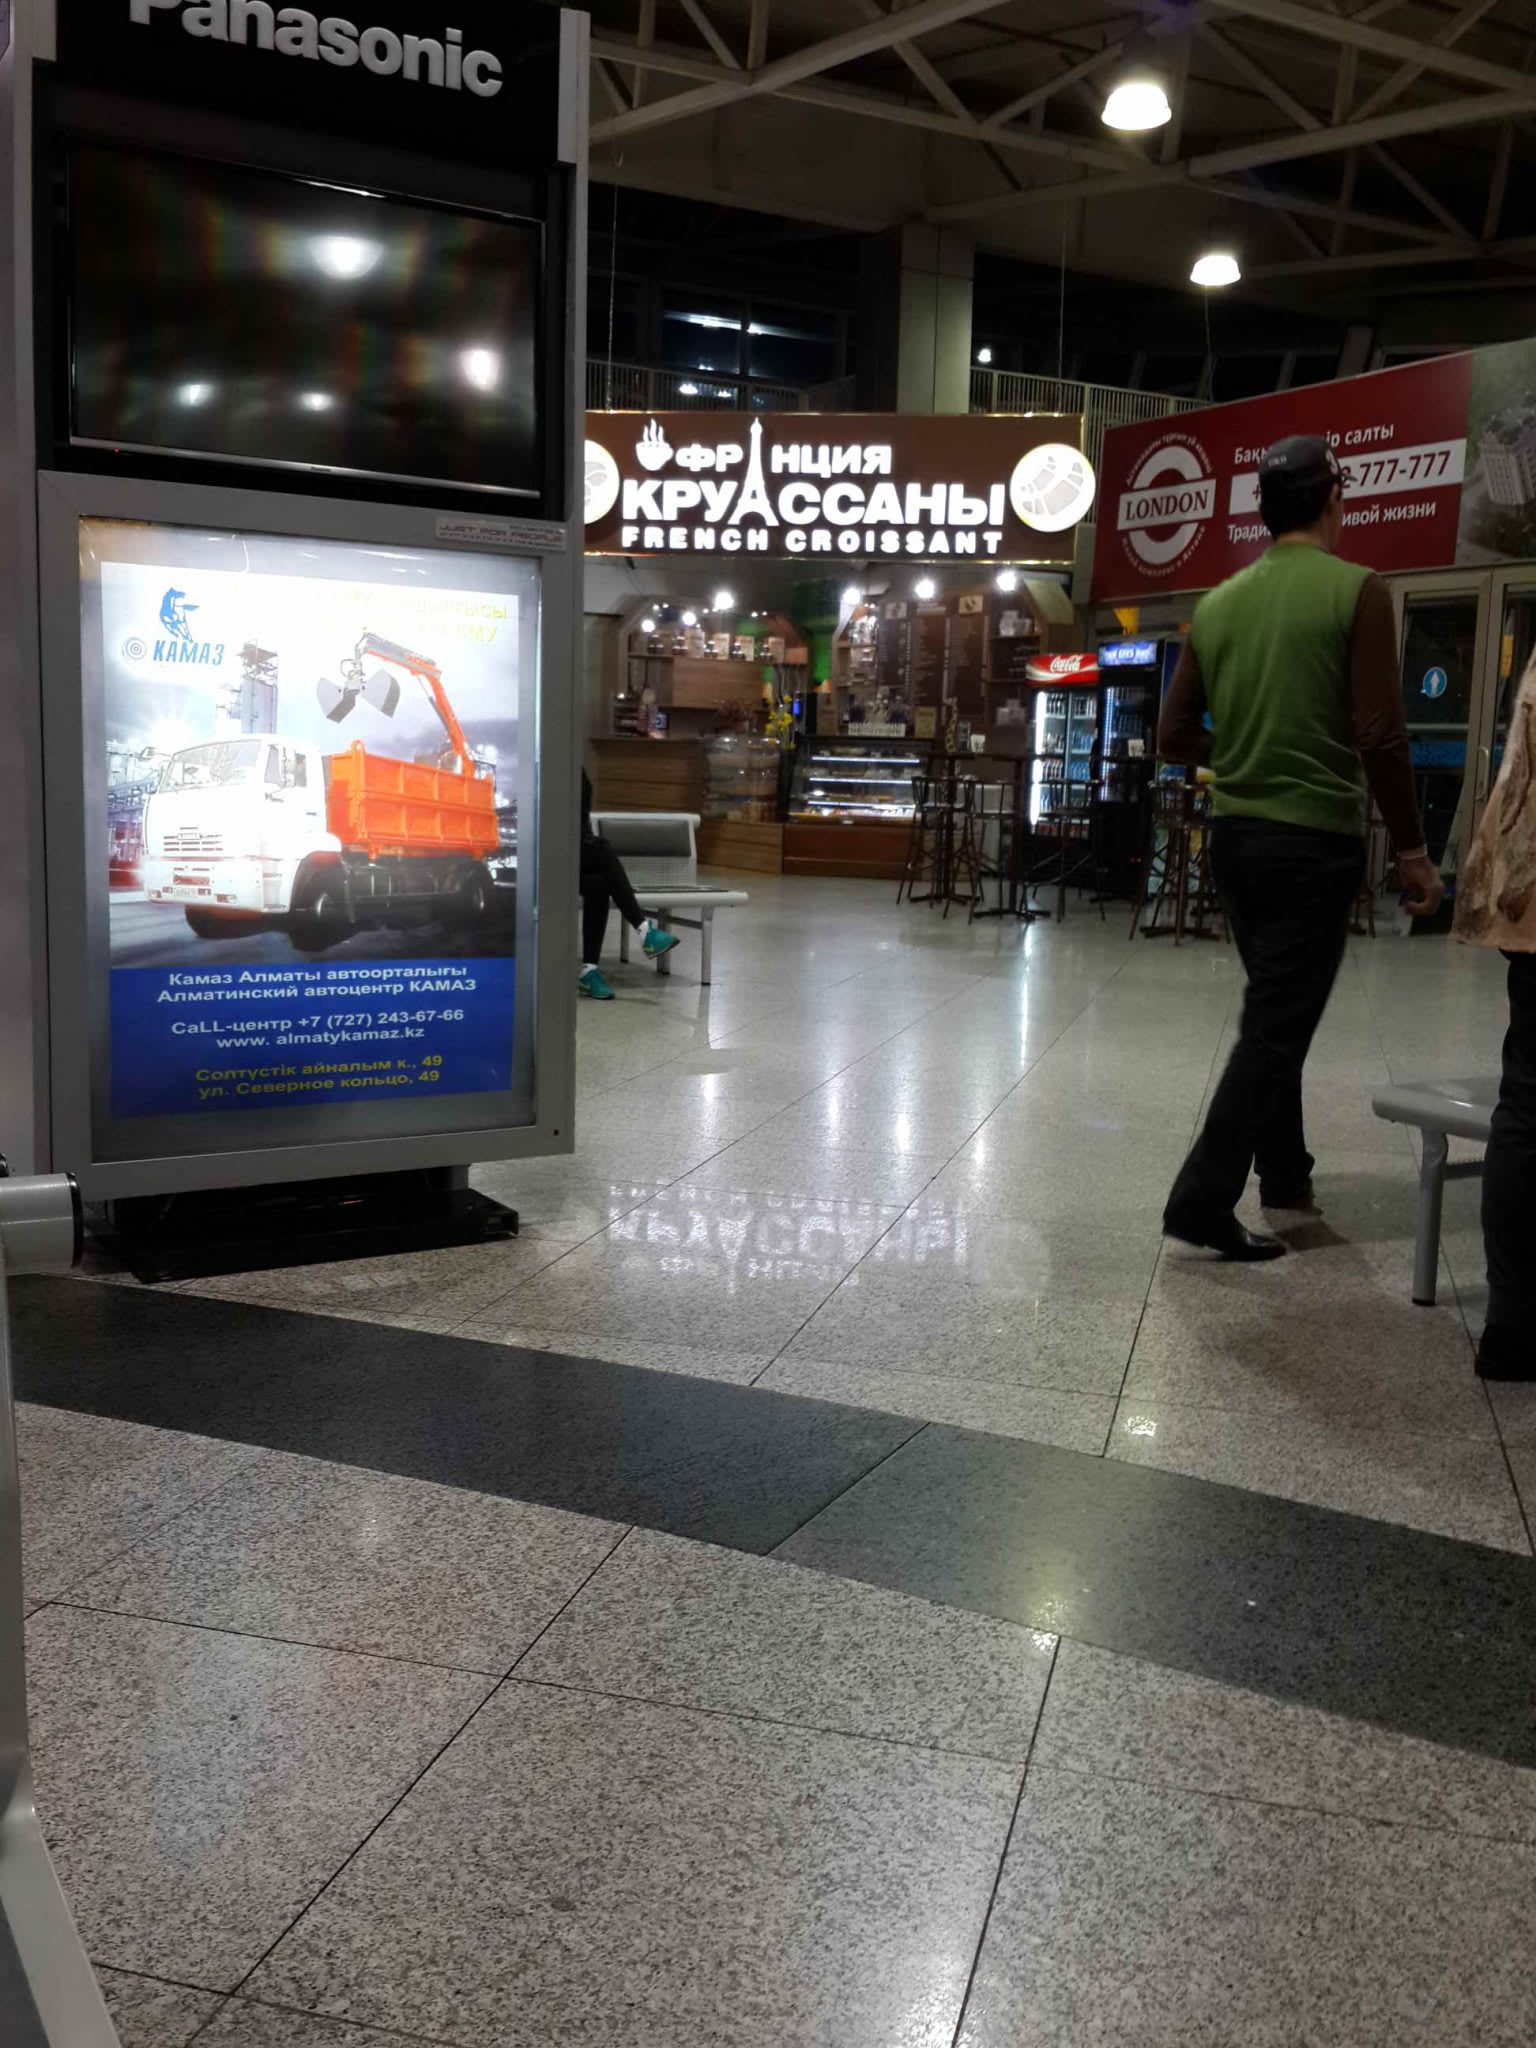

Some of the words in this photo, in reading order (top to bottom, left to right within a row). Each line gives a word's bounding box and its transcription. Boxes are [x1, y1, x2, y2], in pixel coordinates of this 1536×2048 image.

[1344, 424, 1395, 446] салты
[621, 478, 1006, 528] КРУАССАНЫ
[1125, 489, 1210, 521] LONDON
[1383, 502, 1437, 522] жизни
[621, 526, 769, 551] FRENCH
[784, 529, 1003, 555] CROISSANT
[153, 639, 225, 666] КАМАЗ
[169, 972, 233, 986] Камаз
[238, 970, 321, 984] Алматы
[157, 985, 299, 1003] Алматинский
[304, 983, 404, 997] автоцентр
[409, 979, 477, 993] КАМАЗ
[171, 1019, 293, 1035] CaLL-центр
[298, 1015, 321, 1028] +7
[327, 1014, 373, 1030] (727)
[377, 1009, 465, 1025] 243-67-66
[216, 1036, 271, 1049] www.
[276, 1026, 425, 1046] almatykamaz.kz
[302, 1060, 392, 1076] айналым
[422, 1055, 443, 1067] 49
[198, 1085, 231, 1100] ул.
[236, 1079, 335, 1096] Северное
[418, 1070, 440, 1083] 49
